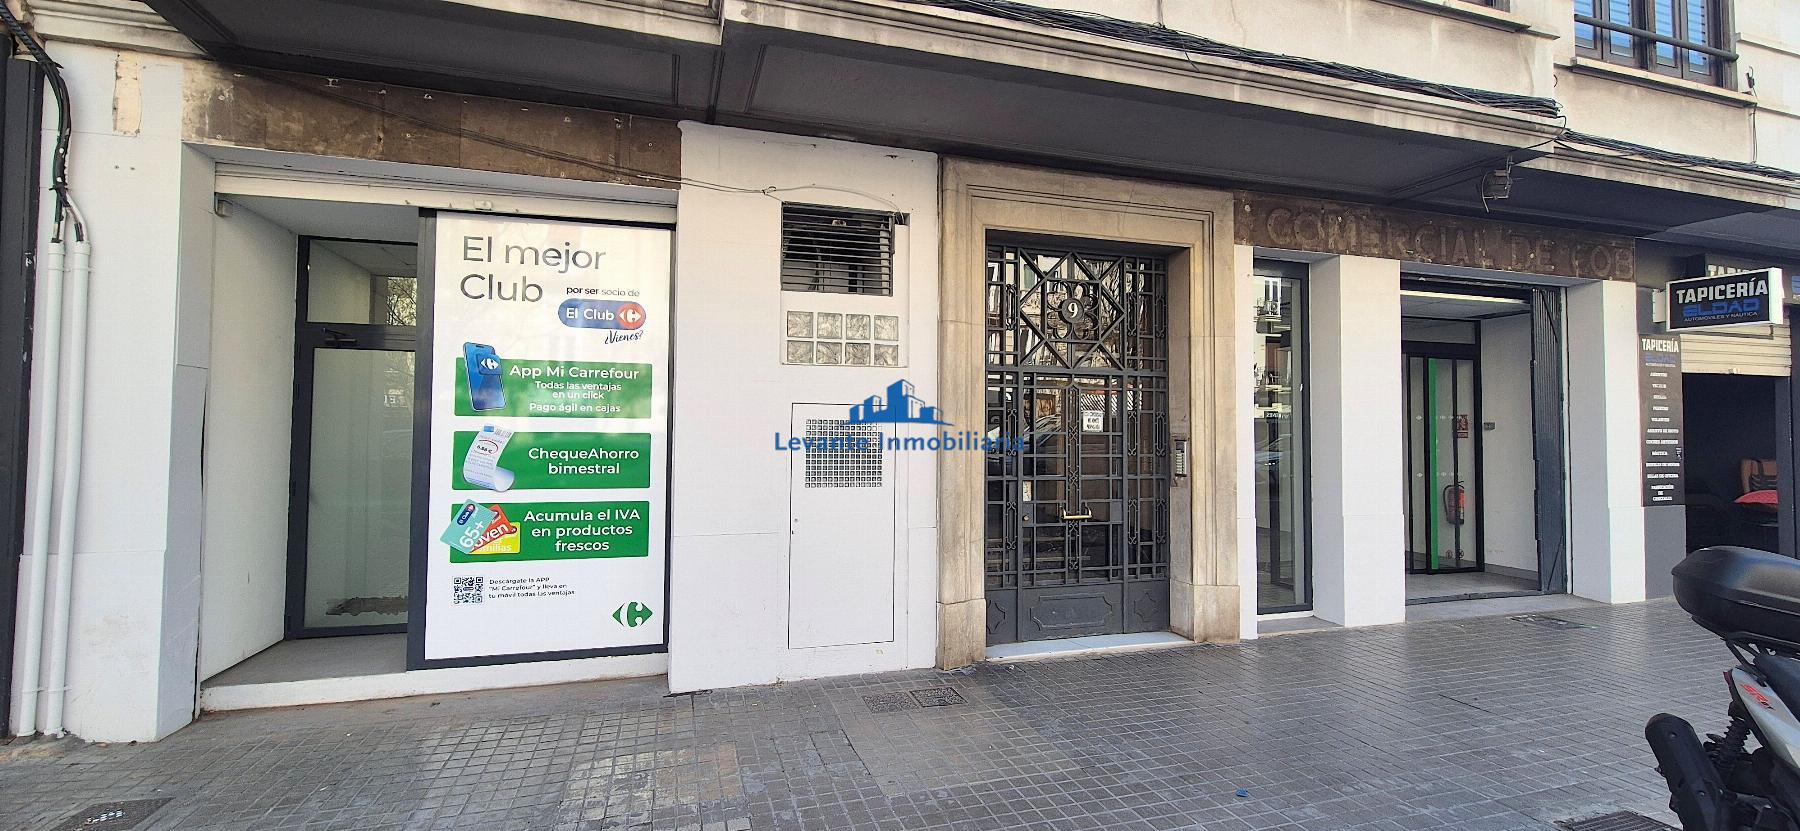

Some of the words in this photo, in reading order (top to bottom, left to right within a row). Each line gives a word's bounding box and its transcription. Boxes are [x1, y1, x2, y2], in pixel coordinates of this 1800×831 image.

[1266, 206, 1494, 266] COMERCIAL
[1510, 234, 1556, 271] DE
[463, 235, 493, 263] El
[505, 241, 607, 274] mejor
[460, 273, 544, 302] Club
[566, 286, 583, 296] por
[584, 288, 599, 296] ser
[601, 288, 626, 297] socio
[627, 288, 641, 297] de
[1676, 277, 1769, 304] TAPICERÍA
[566, 307, 578, 320] El
[583, 308, 615, 321] Club
[1067, 302, 1080, 319] 9
[1683, 297, 1761, 318] ELDAD
[604, 329, 645, 345] ¿Vienes?
[1641, 338, 1680, 353] TAPICERÍA
[509, 364, 542, 378] App
[546, 365, 564, 377] Mi
[568, 366, 640, 380] Carrefour
[535, 380, 565, 389] Todas
[566, 381, 580, 390] las
[582, 382, 622, 392] ventajas
[552, 391, 566, 399] en
[567, 391, 581, 399] un
[582, 390, 605, 399] click
[529, 402, 557, 413] Pago
[558, 401, 578, 413] ágil
[580, 404, 593, 412] en
[595, 403, 621, 414] cajas
[528, 447, 640, 461] ChequeAhorro
[548, 462, 620, 475] bimestral
[523, 509, 593, 522] Acumula
[597, 508, 611, 521] el
[614, 508, 641, 521] IVA
[459, 520, 485, 548] 65+
[531, 527, 551, 537] en
[555, 524, 633, 539] productos
[554, 539, 610, 552] frescos
[489, 577, 527, 586] Descárgate
[547, 589, 576, 598] ventajas
